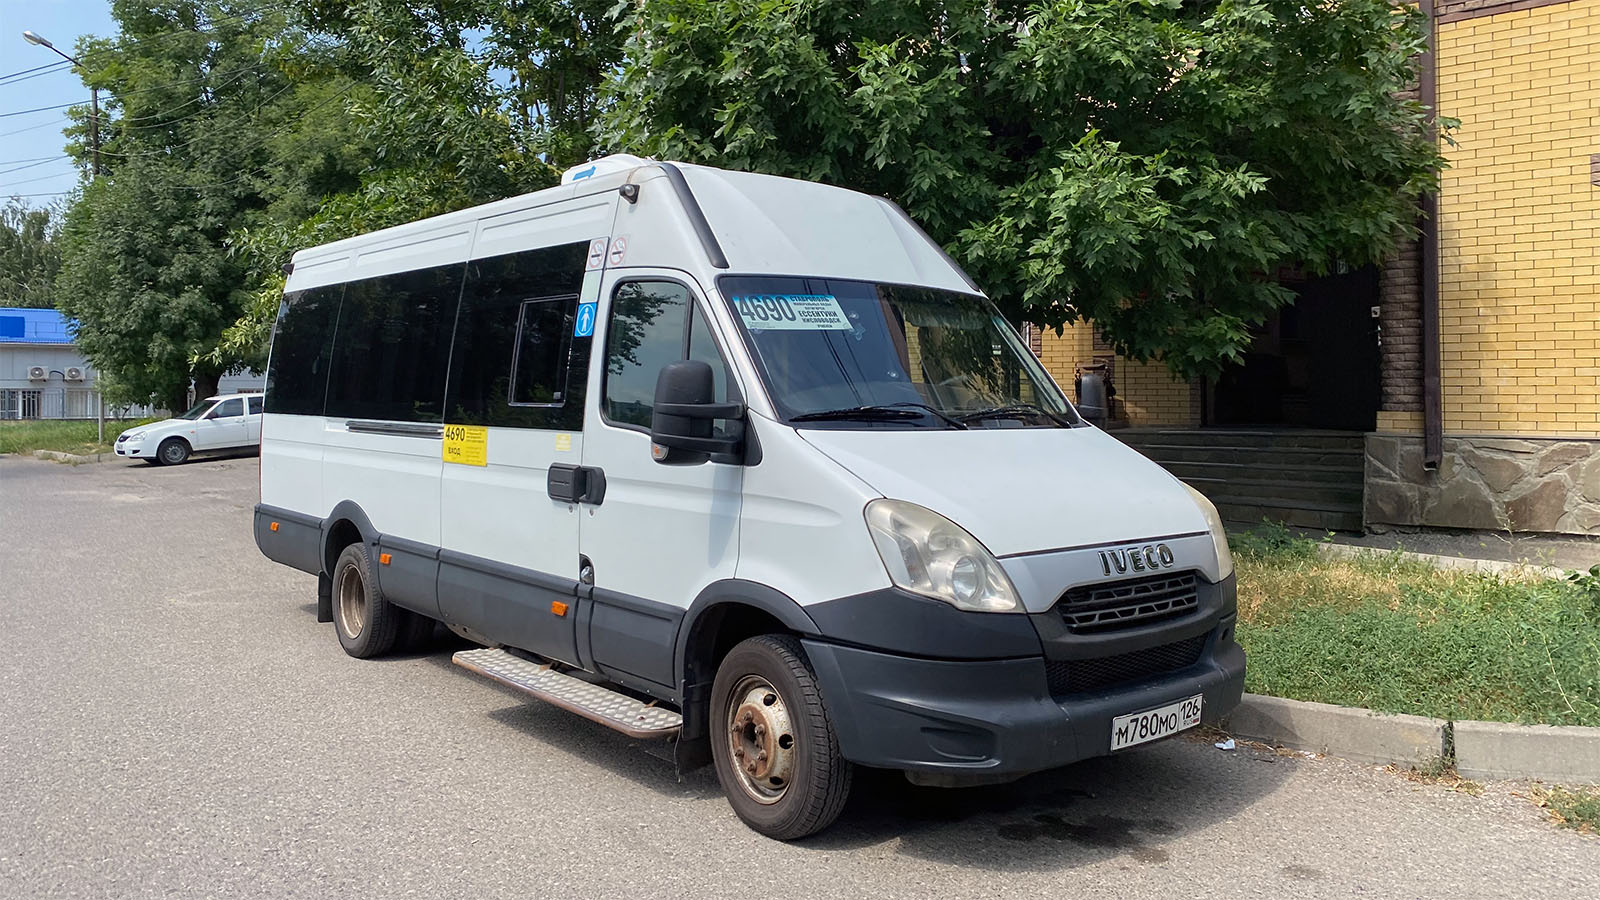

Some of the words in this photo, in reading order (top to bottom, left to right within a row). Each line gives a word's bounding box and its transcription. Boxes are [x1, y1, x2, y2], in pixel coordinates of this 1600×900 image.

[740, 296, 797, 321] 4690
[445, 426, 466, 442] 4690
[1098, 543, 1174, 577] IVECO
[1115, 713, 1178, 746] М780МО
[1180, 698, 1200, 720] 126
